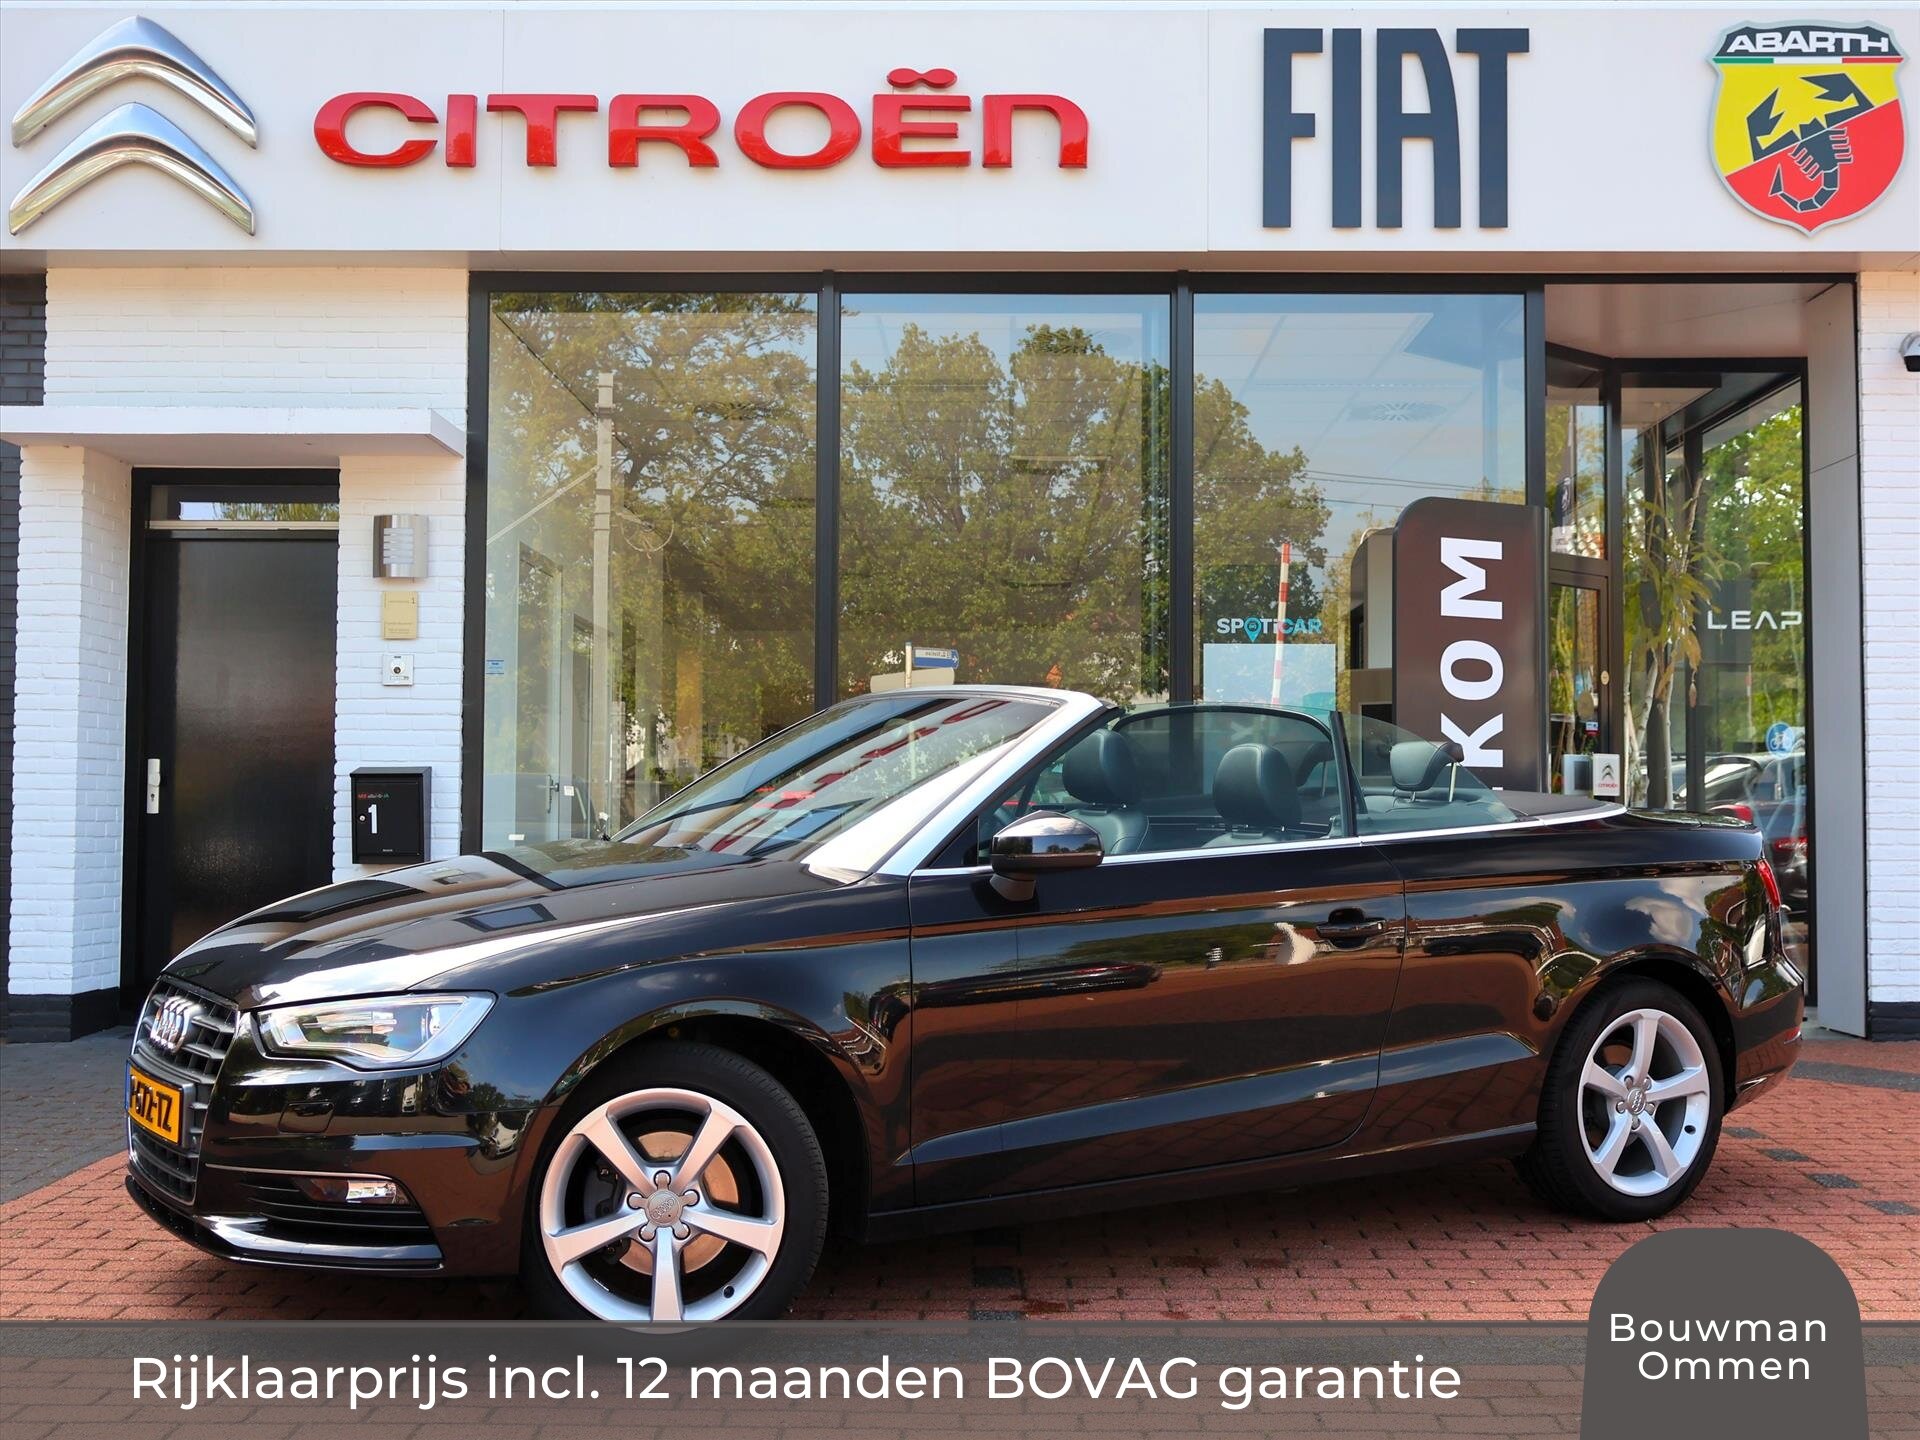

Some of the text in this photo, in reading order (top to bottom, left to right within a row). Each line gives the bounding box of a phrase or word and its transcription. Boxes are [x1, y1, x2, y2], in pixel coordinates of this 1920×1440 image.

[1727, 31, 1888, 53] ABARTH
[314, 68, 1089, 170] CITROËN
[1263, 28, 1529, 228] FIAT
[1440, 537, 1503, 791] KOM
[368, 804, 378, 834] 1
